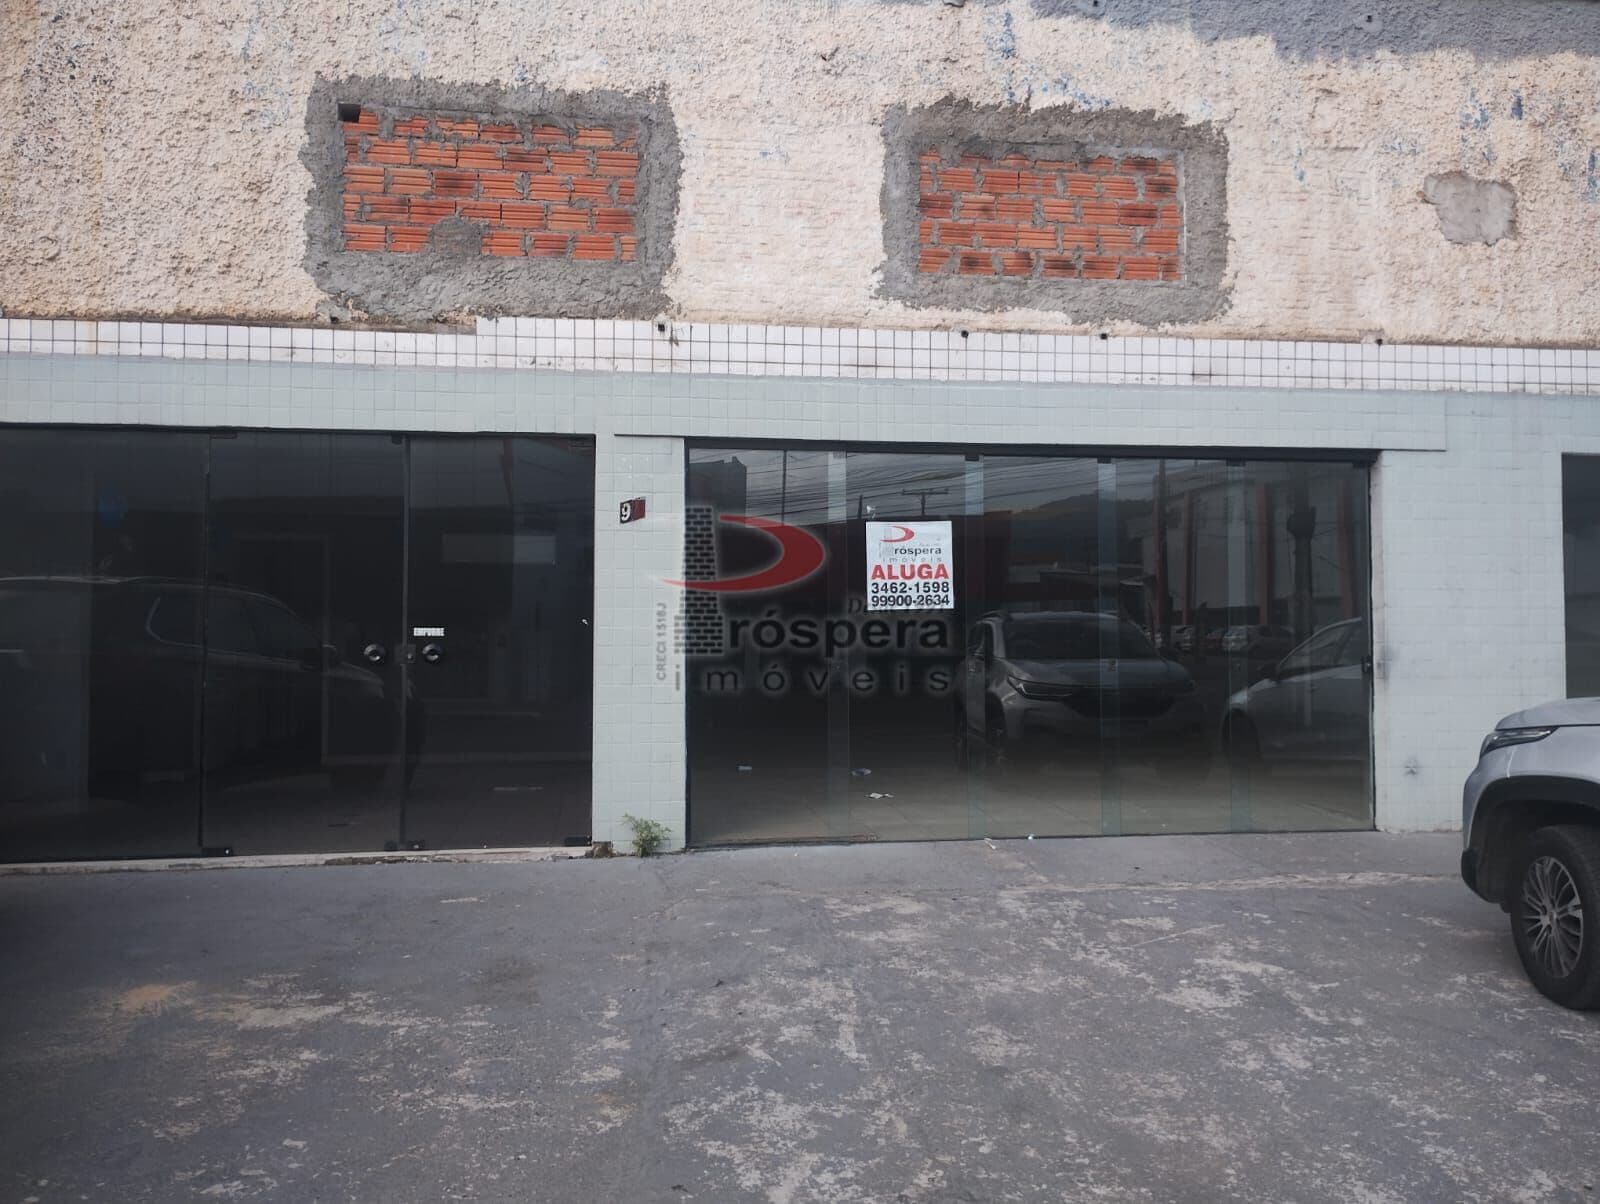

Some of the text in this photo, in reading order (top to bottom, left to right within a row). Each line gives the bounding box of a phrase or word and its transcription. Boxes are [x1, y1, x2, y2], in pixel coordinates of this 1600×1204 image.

[621, 502, 631, 521] 9
[871, 564, 949, 580] ALUGA
[871, 582, 950, 593] 3462-1598
[871, 595, 950, 607] 99900-2634
